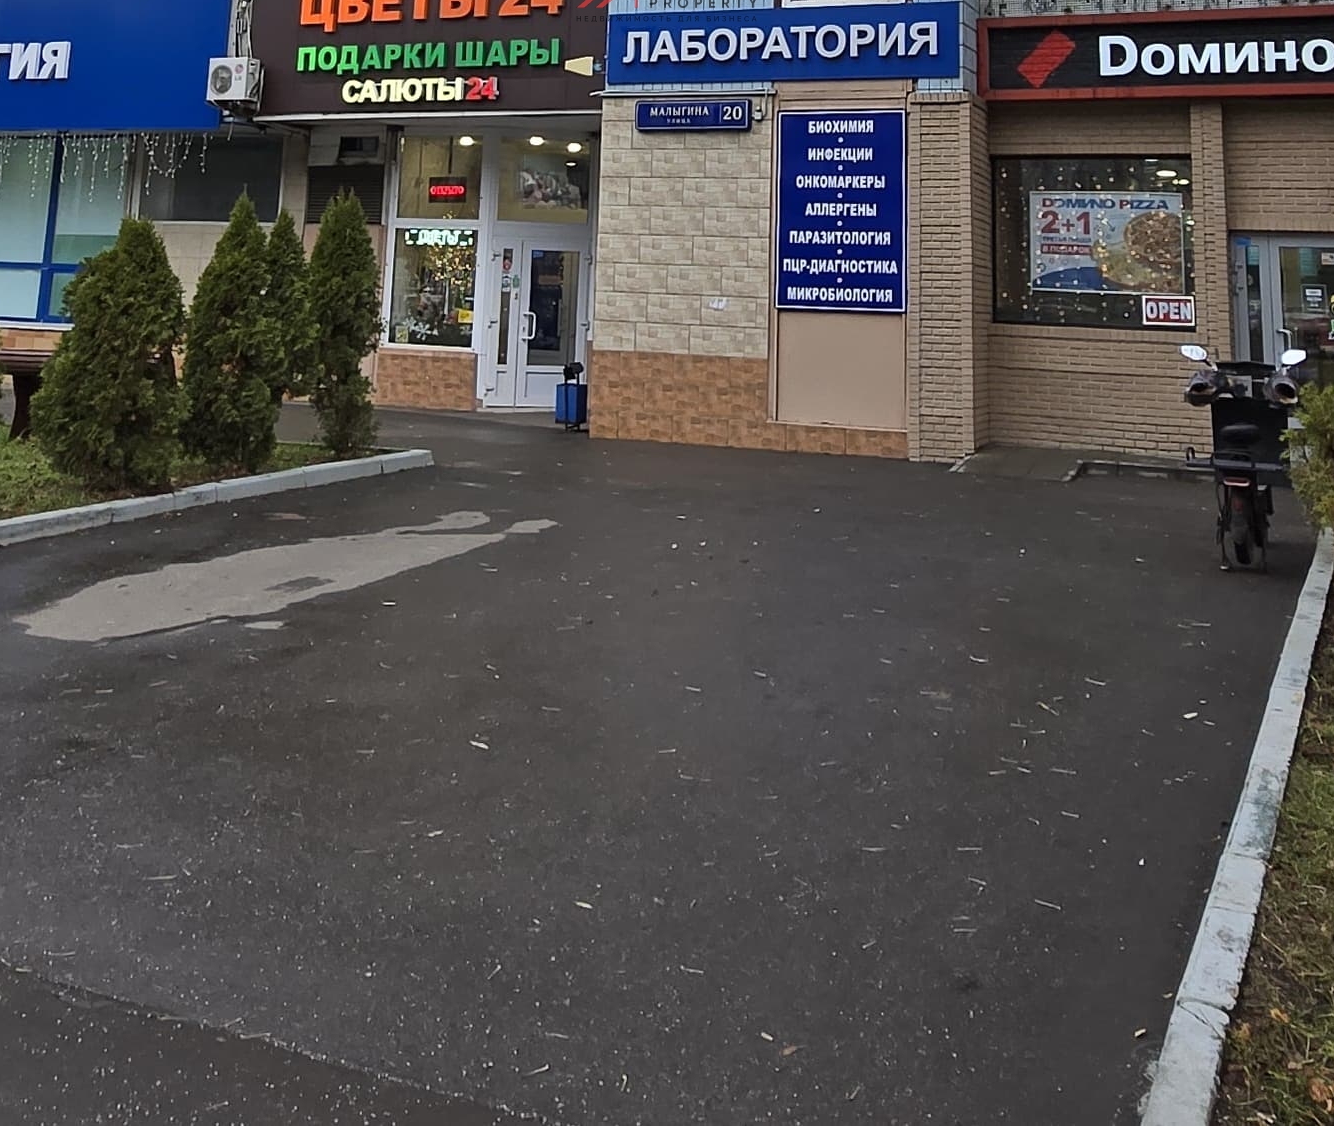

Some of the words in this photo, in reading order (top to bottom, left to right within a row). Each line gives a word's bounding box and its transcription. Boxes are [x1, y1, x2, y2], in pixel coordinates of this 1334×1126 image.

[622, 20, 939, 64] ЛАБОРАТОРИЯ
[296, 41, 446, 75] ПОДАРКИ
[454, 37, 560, 69] ШАРЫ
[341, 77, 463, 104] САЛЮТЫ
[464, 76, 499, 101] 24
[649, 105, 710, 117] МАЛЫГИНА
[722, 105, 742, 120] 20
[808, 120, 874, 134] БИОХИМИЯ
[808, 147, 873, 163] ИНФЕКЦИИ
[795, 175, 886, 189] ОНКОМАРКЕРЫ
[805, 202, 877, 217] АЛЛЕРГЕНЫ
[1119, 199, 1168, 210] PIZZA
[1040, 210, 1091, 235] 2+1
[789, 230, 891, 245] ПАРАЗИТОЛОГИЯ
[783, 258, 898, 275] ПЦР-ДИАГНОСТИКА
[787, 286, 893, 303] МИКРОБИОЛОГИЯ
[1145, 301, 1192, 320] OPEN
